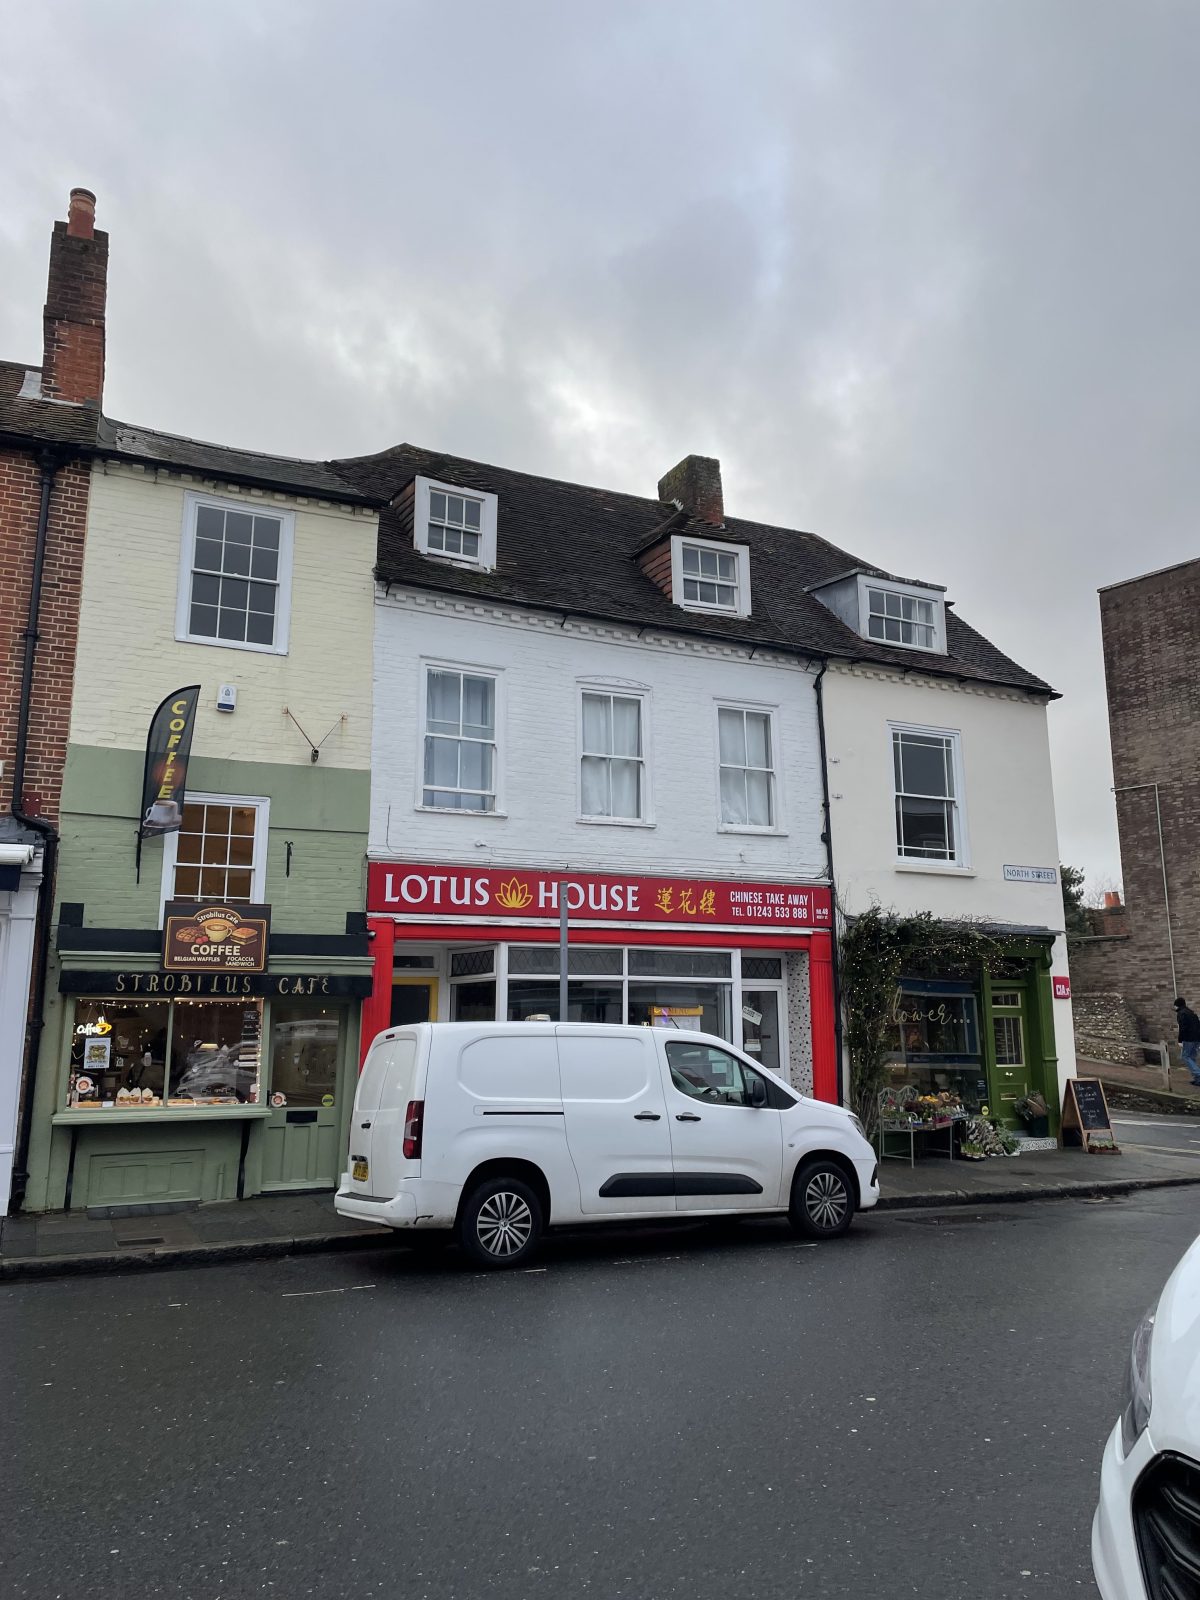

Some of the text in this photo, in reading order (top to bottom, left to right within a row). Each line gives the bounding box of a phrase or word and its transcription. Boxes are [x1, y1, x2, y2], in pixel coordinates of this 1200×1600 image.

[157, 700, 187, 799] COFFEE
[1006, 868, 1055, 880] NORTH STREET
[384, 873, 642, 913] LOTUS HOUSE
[730, 890, 809, 906] CHINESE TAKE AWAY
[197, 911, 225, 923] Strobilus
[732, 906, 745, 917] TEL.
[746, 905, 772, 918] 01243
[775, 907, 790, 919] 533
[792, 908, 808, 919] 888
[190, 944, 241, 956] COFFEE
[115, 974, 252, 994] STROBILUS
[893, 985, 971, 1026] lower...
[77, 1022, 103, 1036] Coffee
